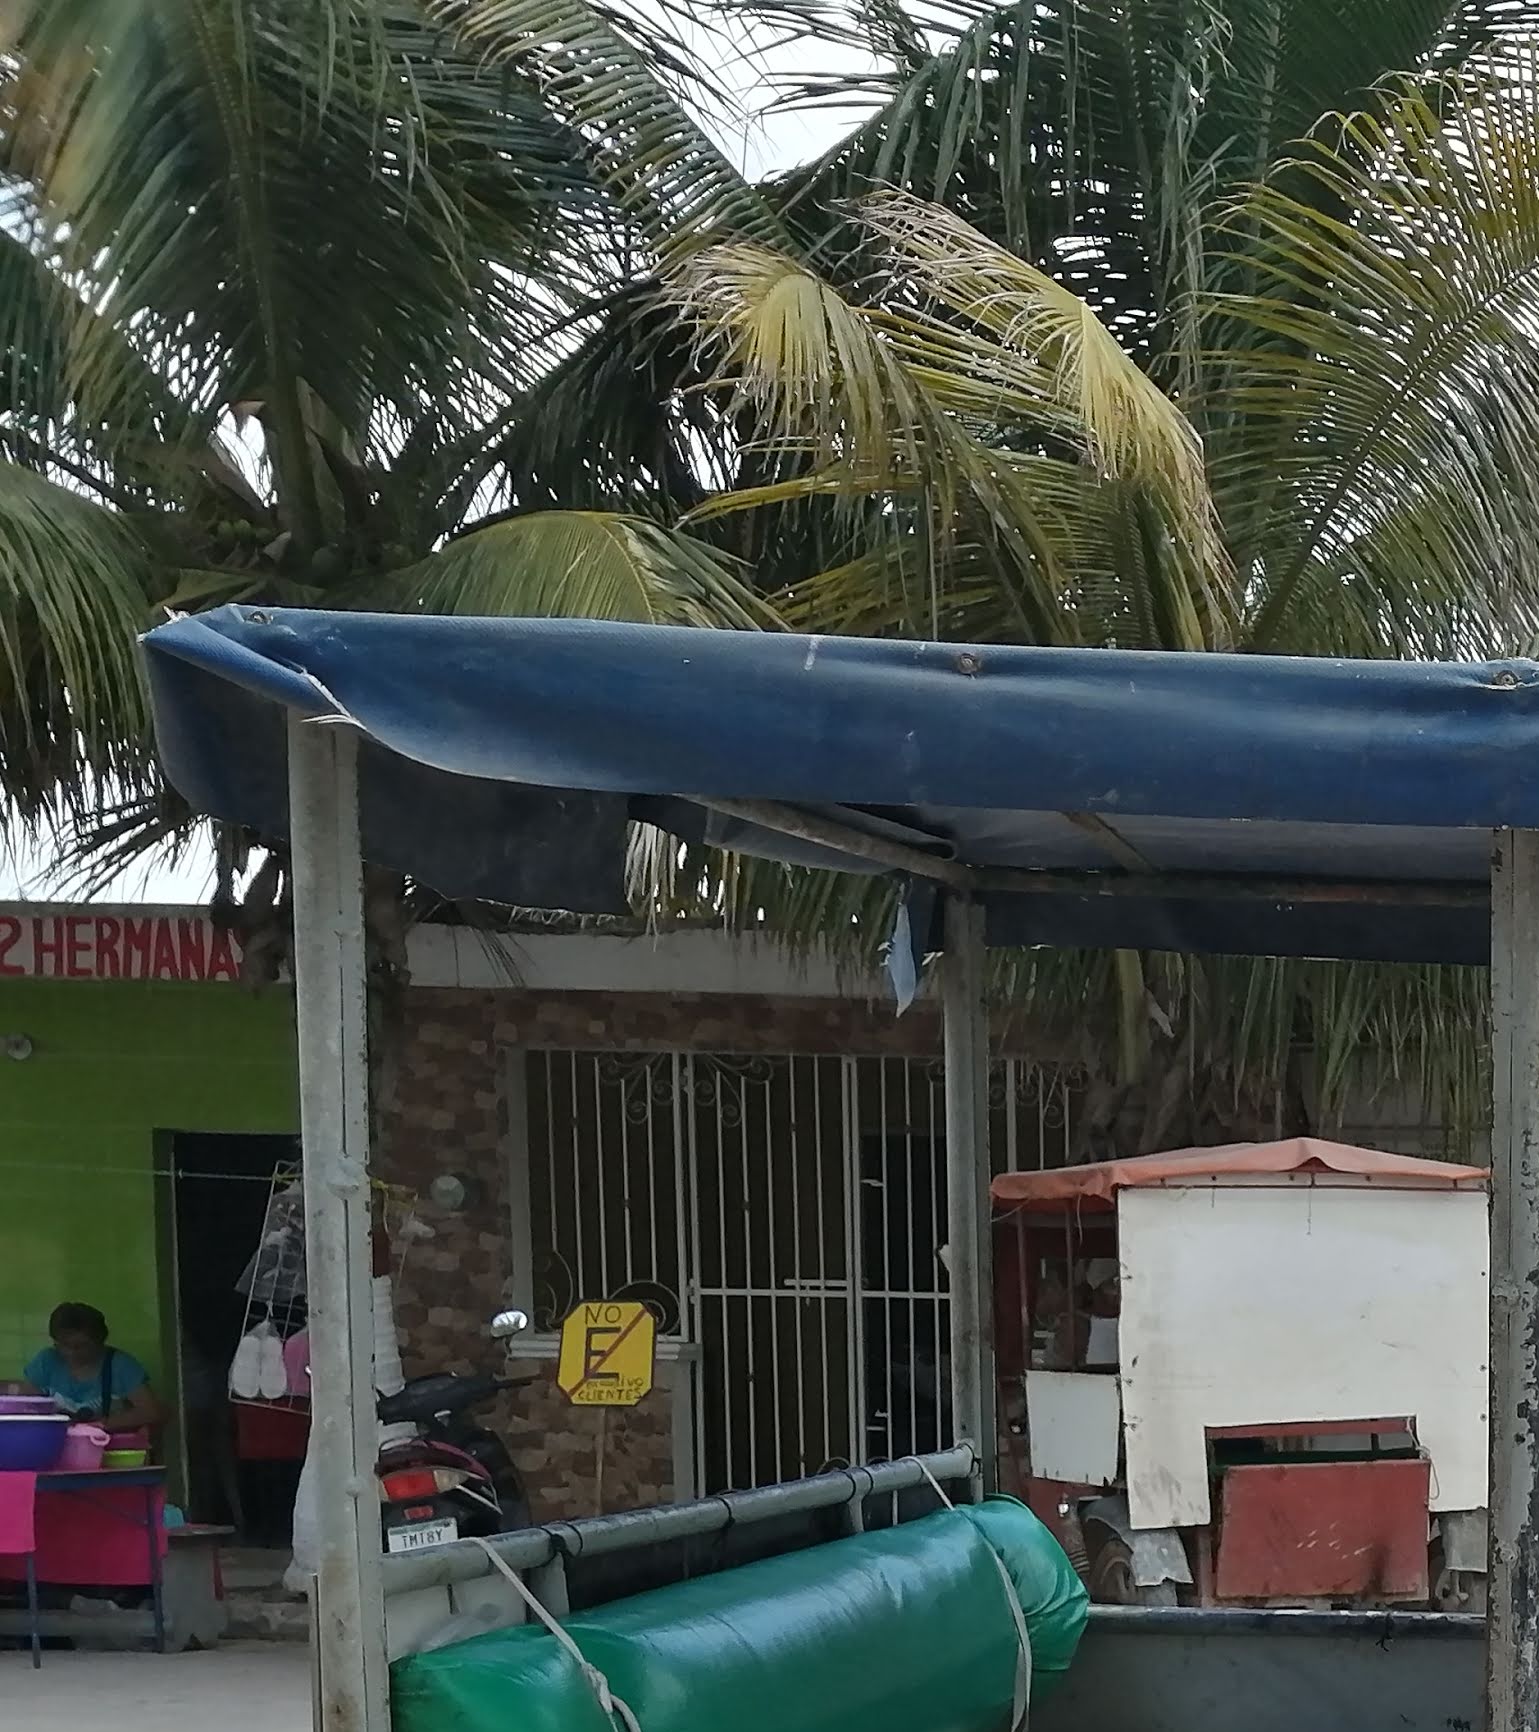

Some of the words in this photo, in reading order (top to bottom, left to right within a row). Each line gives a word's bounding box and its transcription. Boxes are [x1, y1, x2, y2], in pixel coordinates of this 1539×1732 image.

[32, 915, 246, 980] HERMANA
[585, 1304, 622, 1324] NO
[584, 1326, 622, 1380] E
[578, 1389, 642, 1401] CLIENTES
